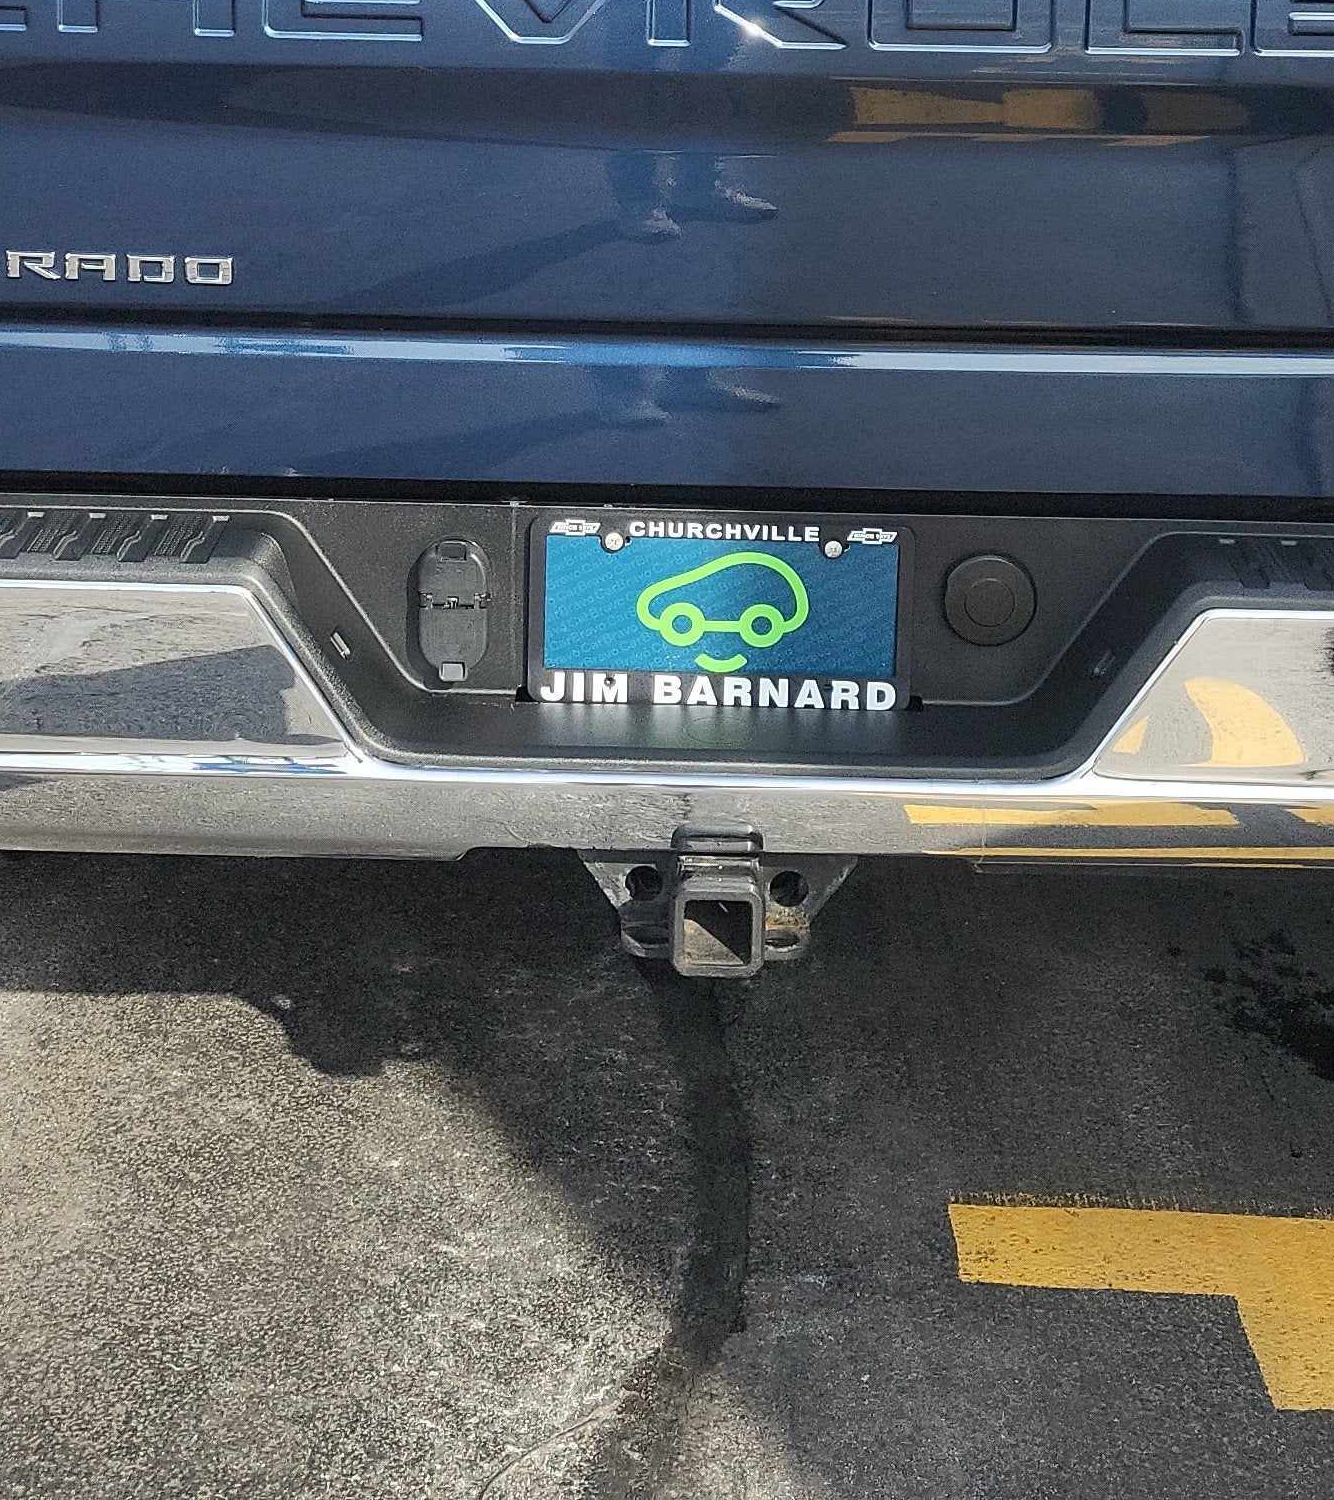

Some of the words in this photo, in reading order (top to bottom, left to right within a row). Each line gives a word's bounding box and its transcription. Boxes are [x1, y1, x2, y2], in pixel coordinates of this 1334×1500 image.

[629, 522, 820, 542] CHURCHVILLE
[540, 671, 629, 704] JIM
[653, 674, 897, 711] BARNARD
